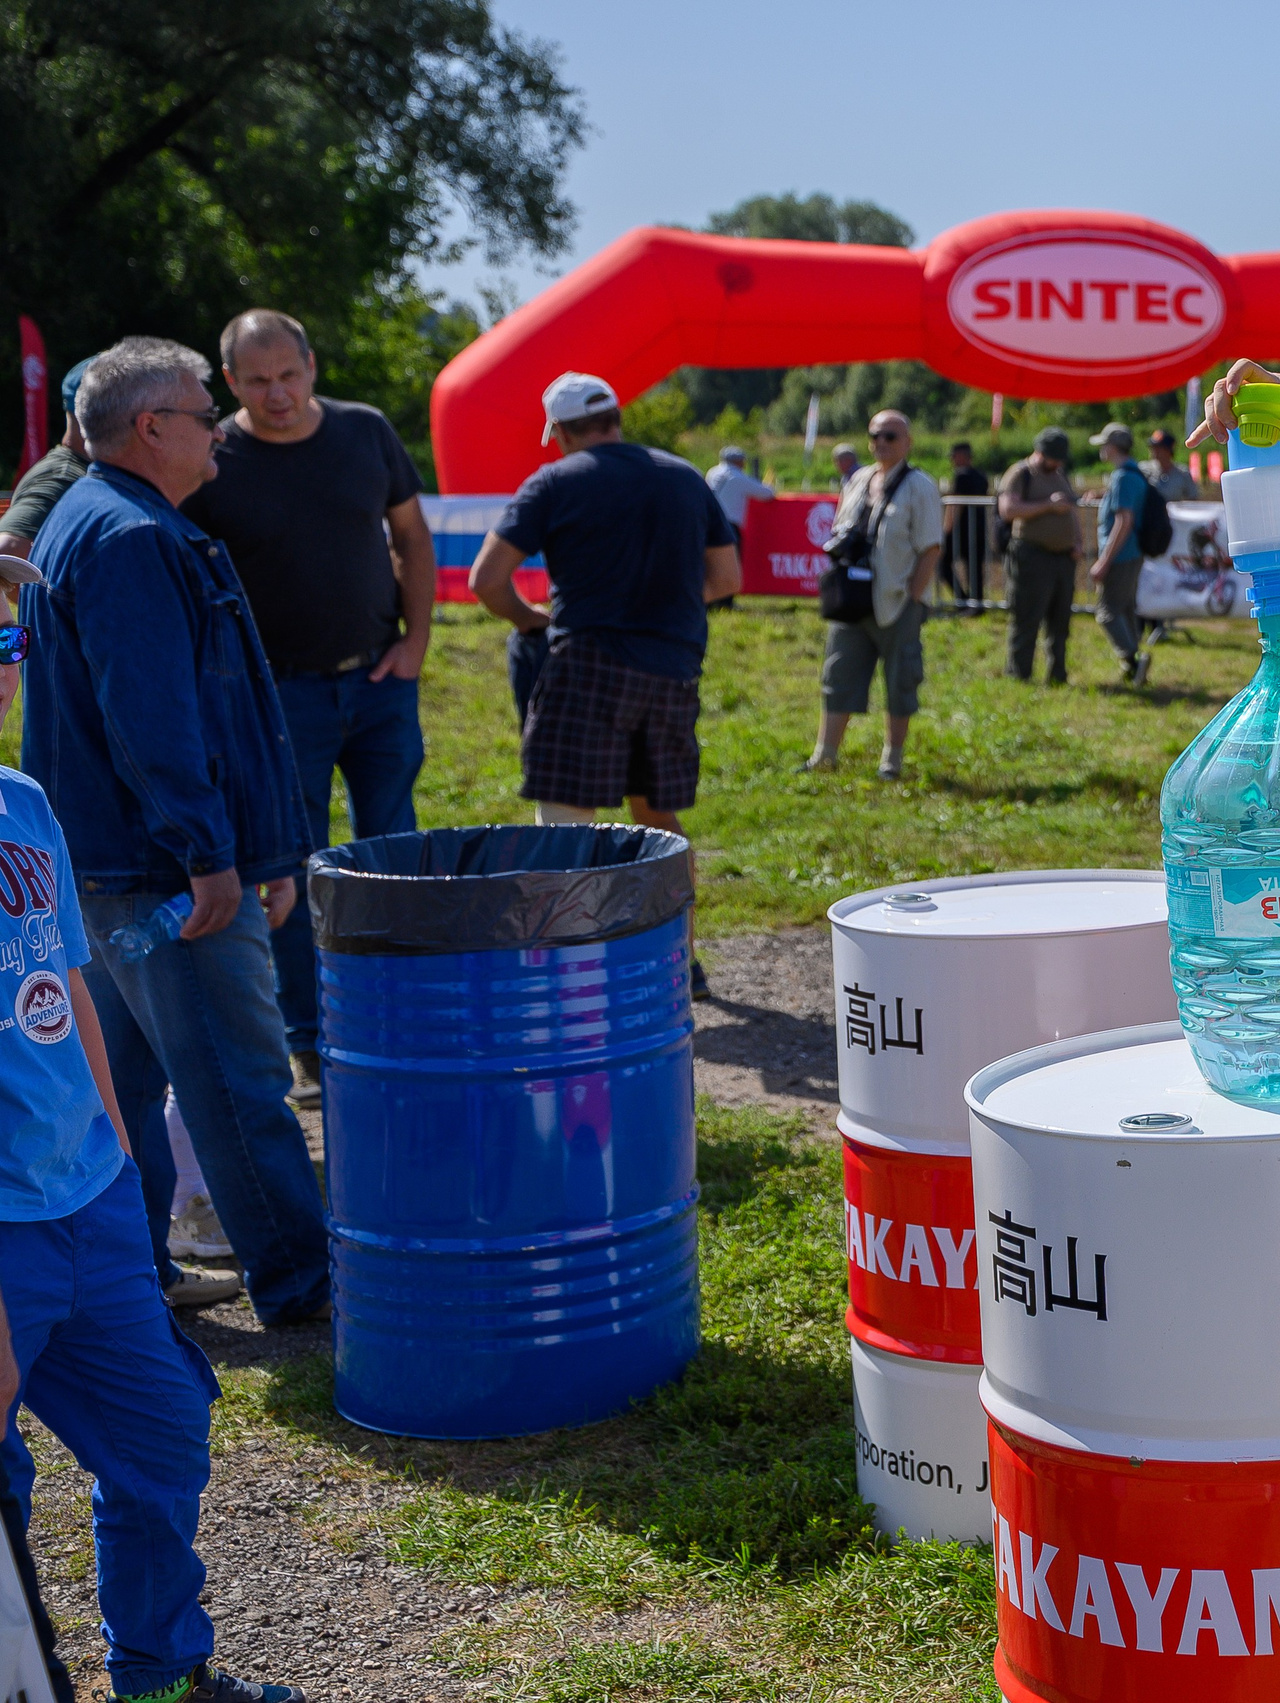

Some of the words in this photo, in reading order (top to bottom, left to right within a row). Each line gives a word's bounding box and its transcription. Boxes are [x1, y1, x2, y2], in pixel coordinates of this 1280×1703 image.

[973, 279, 1203, 325] SINTEC
[25, 1001, 69, 1029] ADVENTURE
[843, 982, 924, 1055] 高山
[844, 1196, 979, 1290] AKAY
[988, 1209, 1108, 1322] 高山
